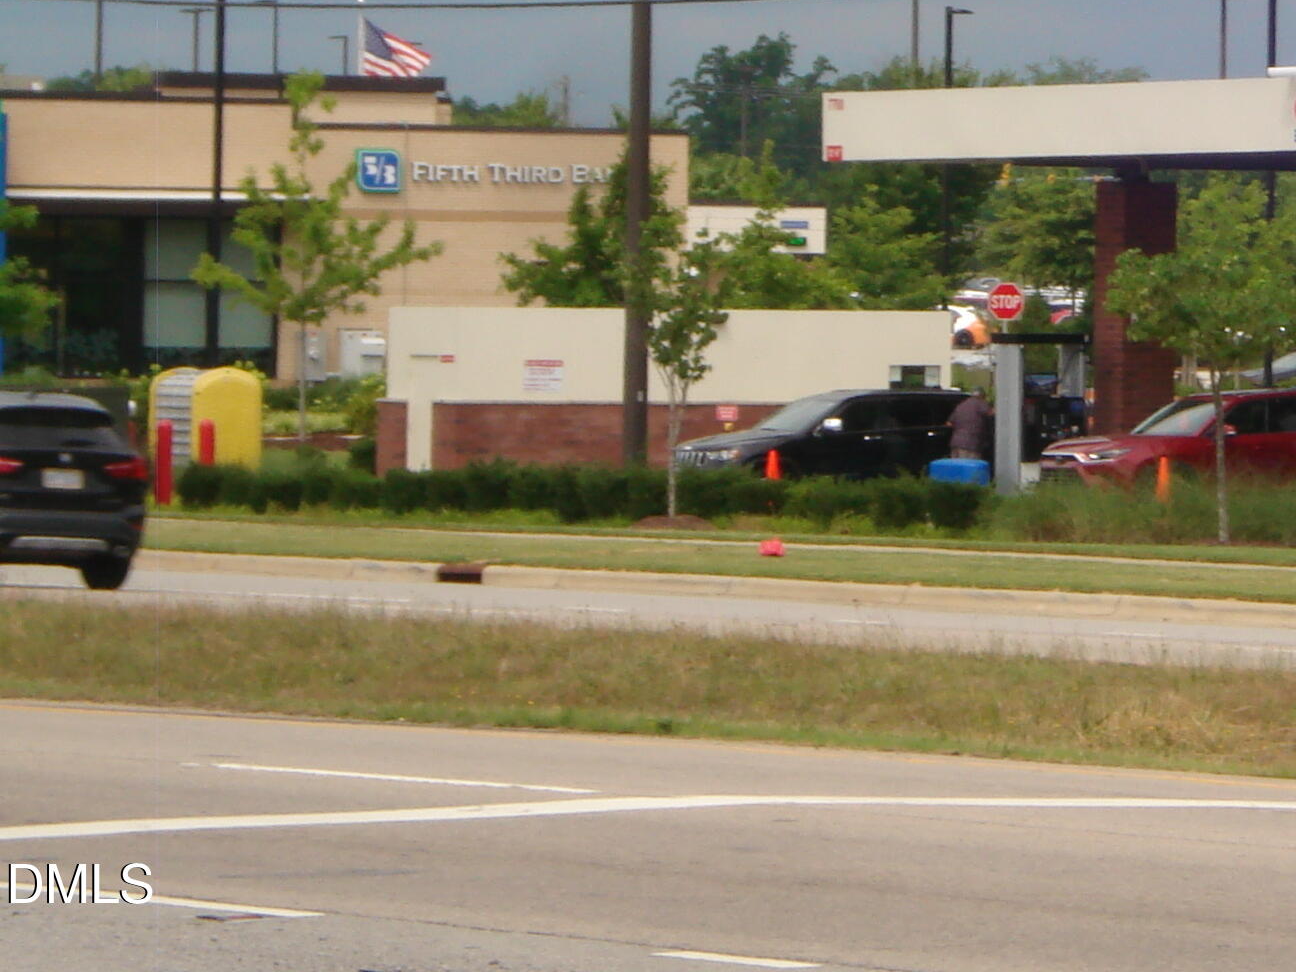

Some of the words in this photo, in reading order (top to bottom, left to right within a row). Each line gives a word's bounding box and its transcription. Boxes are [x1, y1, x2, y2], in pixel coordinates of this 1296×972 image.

[411, 161, 480, 183] FIFTH
[487, 163, 564, 184] THIRD
[991, 294, 1021, 309] STOP
